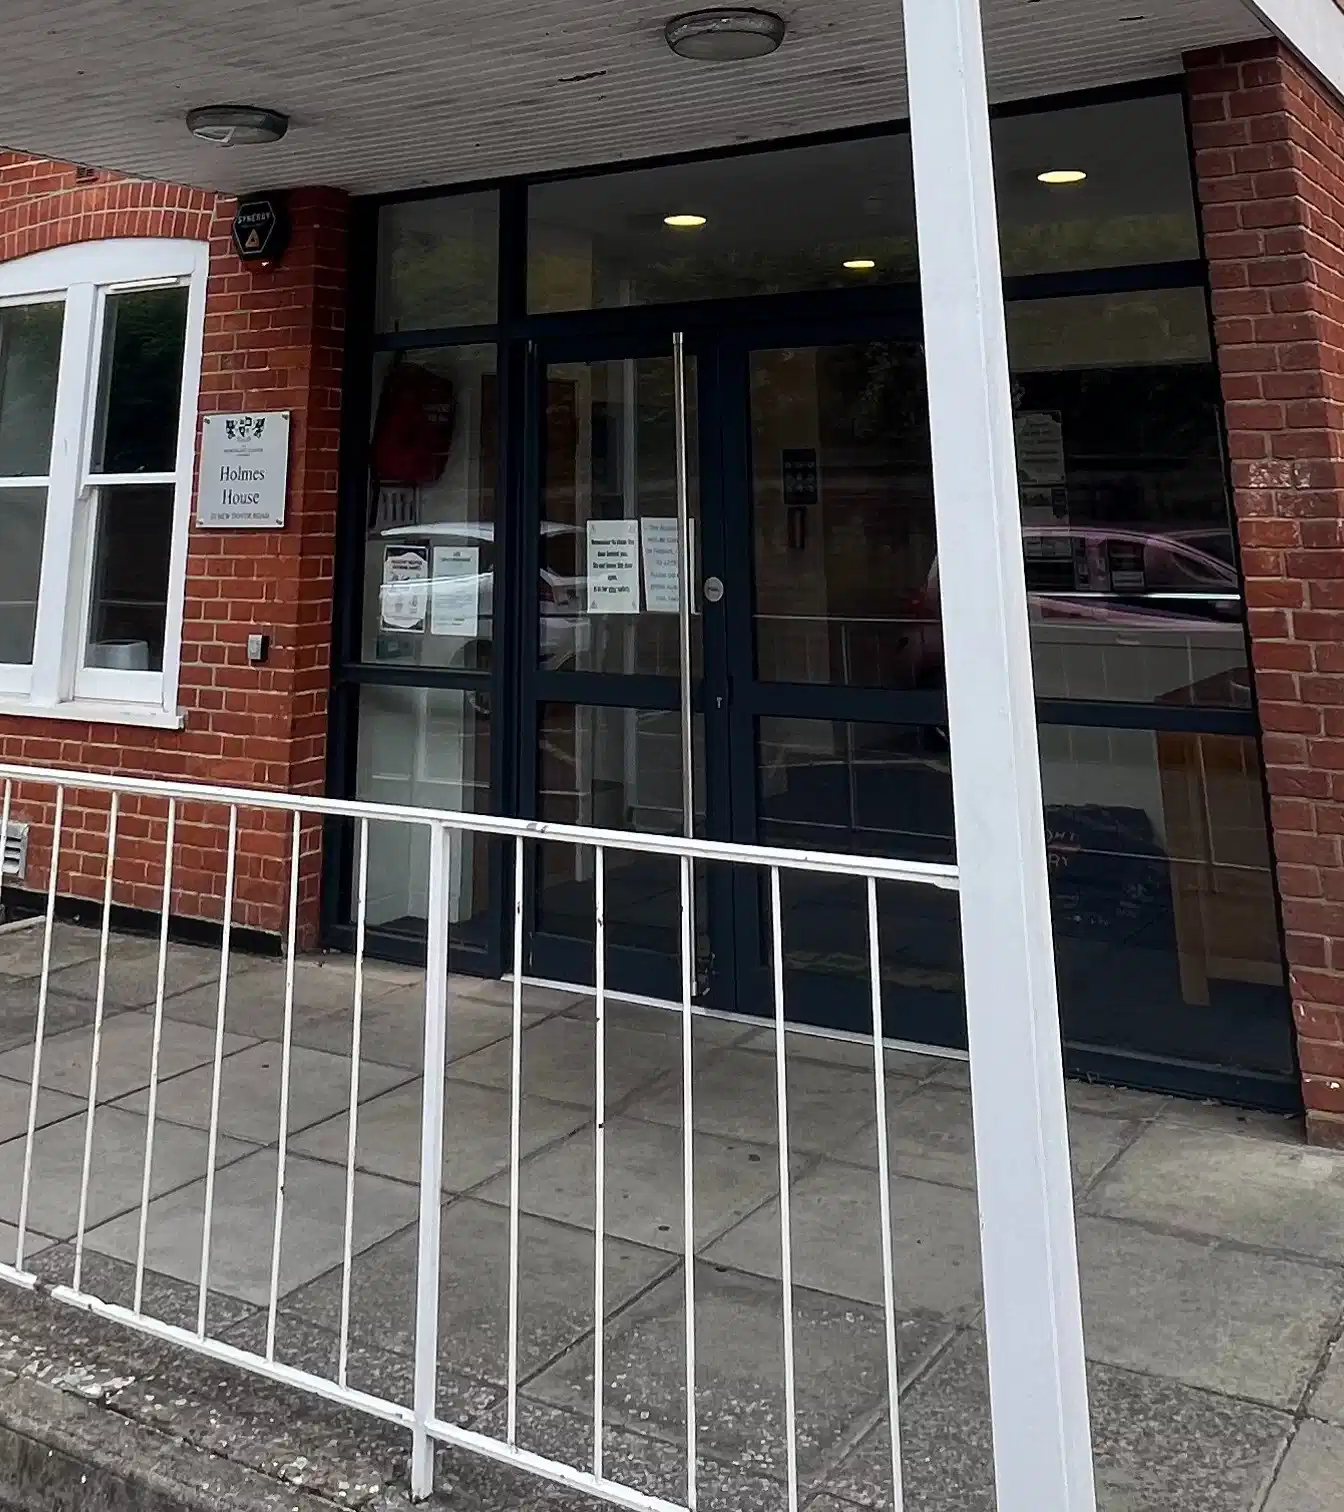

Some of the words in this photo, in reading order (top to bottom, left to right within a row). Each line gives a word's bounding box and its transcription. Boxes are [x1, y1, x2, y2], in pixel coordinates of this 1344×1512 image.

[237, 212, 271, 224] SYNERGY
[220, 465, 265, 481] Holmes
[222, 488, 260, 505] House
